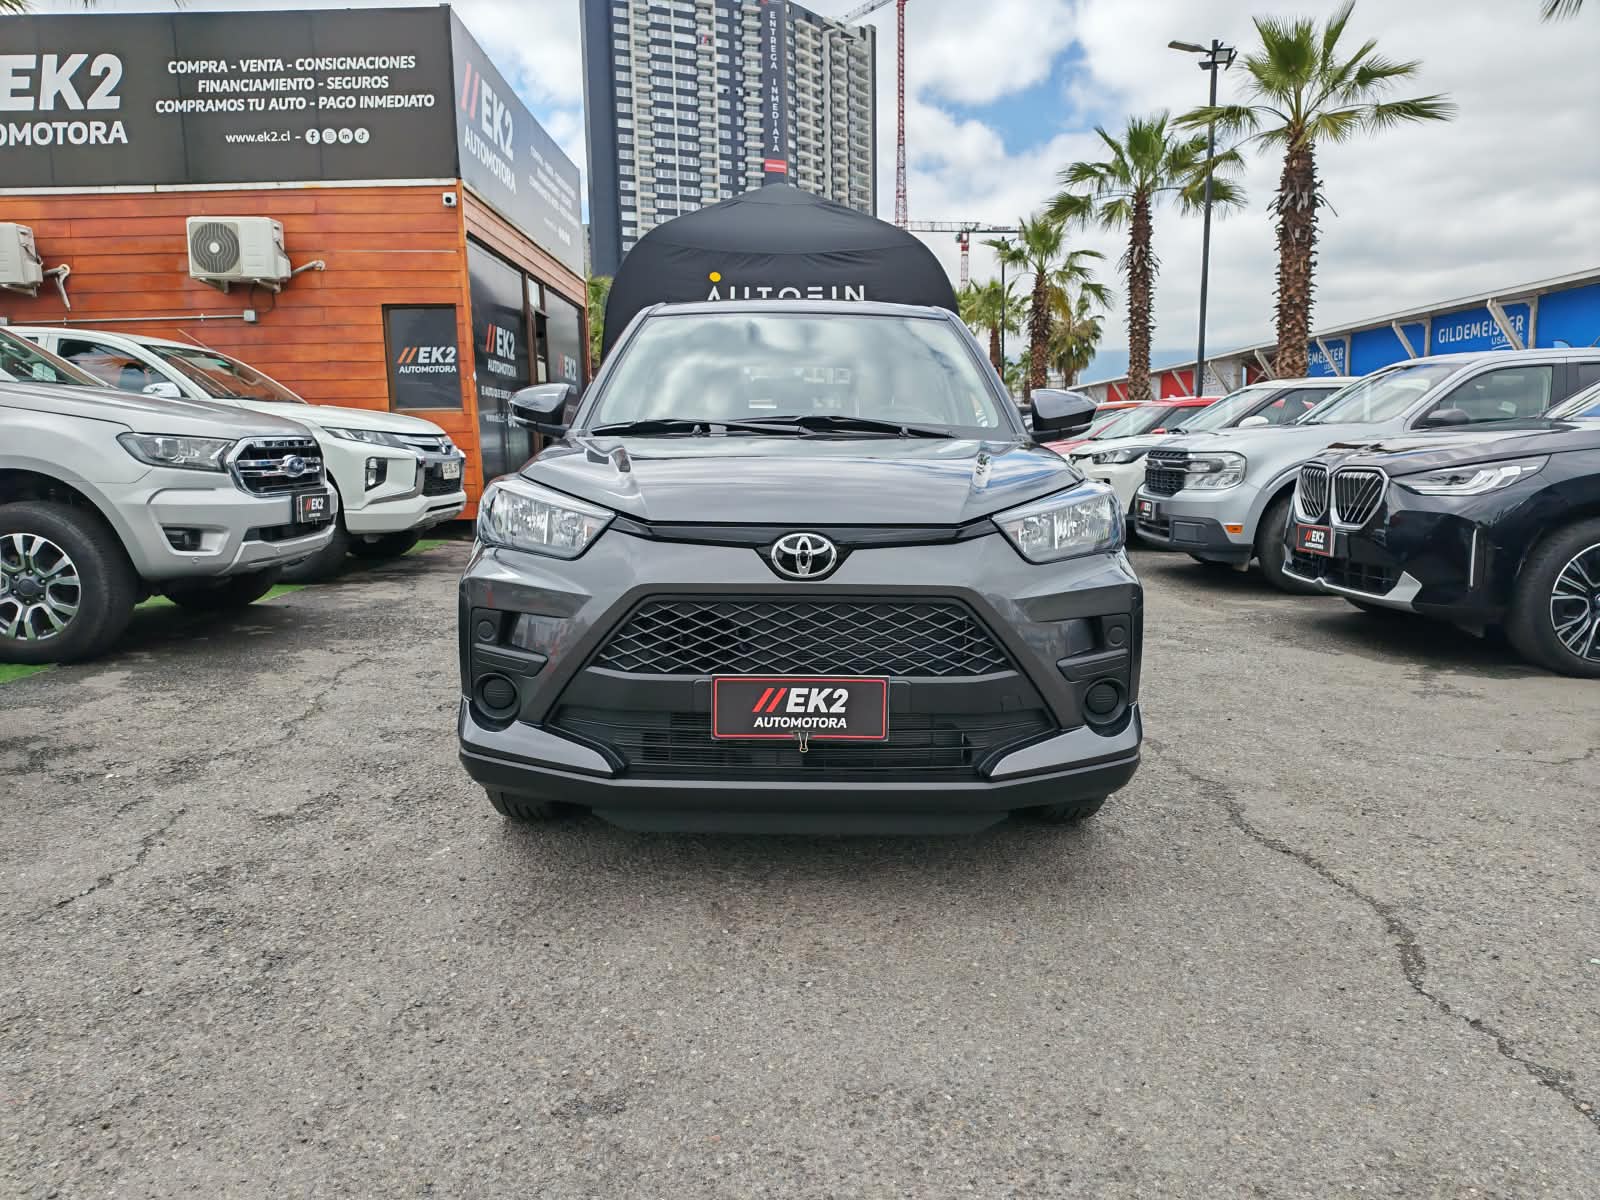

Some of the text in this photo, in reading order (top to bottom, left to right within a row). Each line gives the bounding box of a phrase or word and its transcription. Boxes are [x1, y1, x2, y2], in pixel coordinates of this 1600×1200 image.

[769, 11, 778, 70] ENTREGA
[168, 60, 228, 74] COMPRA
[240, 59, 284, 72] VENTA
[295, 56, 416, 72] CONSIGNACIONES
[198, 77, 315, 93] FINANCIAMIENTO
[327, 76, 389, 90] SEGUROS
[155, 98, 245, 113] COMPRAMOS
[248, 98, 265, 111] TU
[268, 97, 306, 111] AUTO
[318, 96, 356, 110] PAGO
[359, 94, 435, 109] INMEDIATO
[770, 78, 780, 152] INMEDIATA
[225, 130, 290, 143] www.ek2.cl
[464, 125, 517, 194] AUTOMOTORA
[399, 365, 457, 374] AUTOMOTORA
[753, 716, 847, 729] AUTOMOTORA
